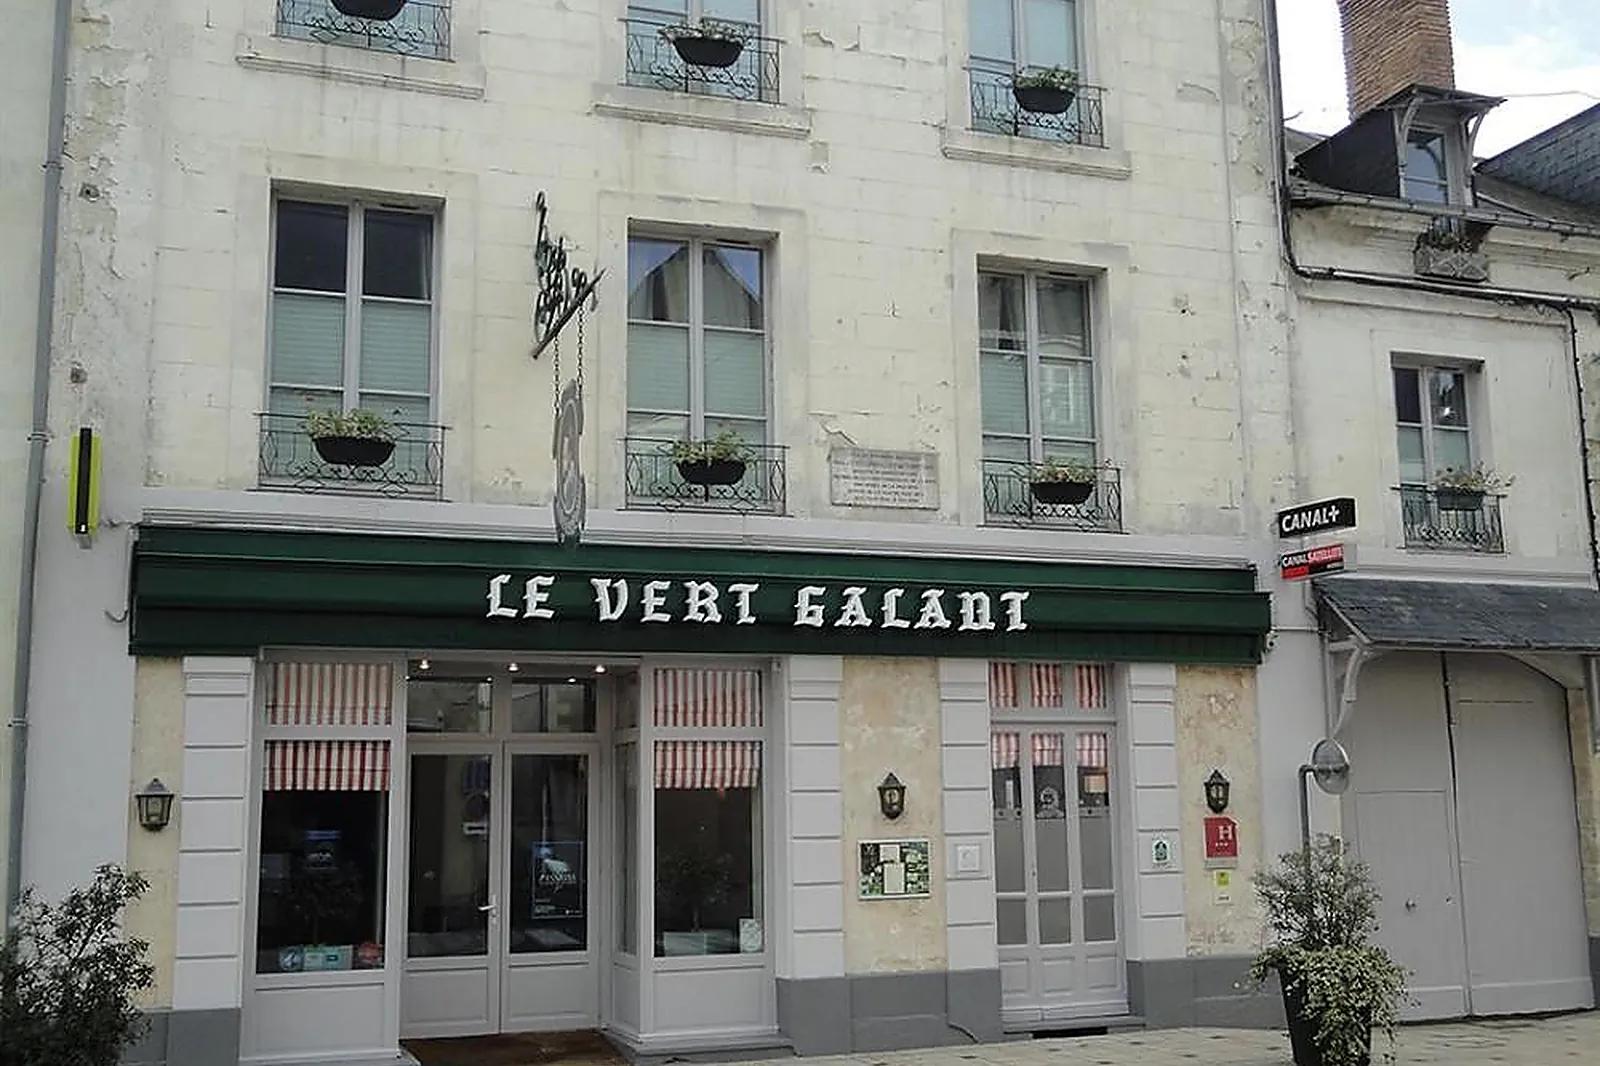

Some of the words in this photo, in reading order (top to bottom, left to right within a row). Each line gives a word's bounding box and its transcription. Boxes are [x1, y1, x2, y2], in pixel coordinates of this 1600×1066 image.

[1282, 505, 1340, 532] CANAL+
[486, 574, 555, 619] LE
[590, 578, 759, 625] VERT
[794, 586, 1030, 631] GALANT
[1218, 825, 1233, 841] H
